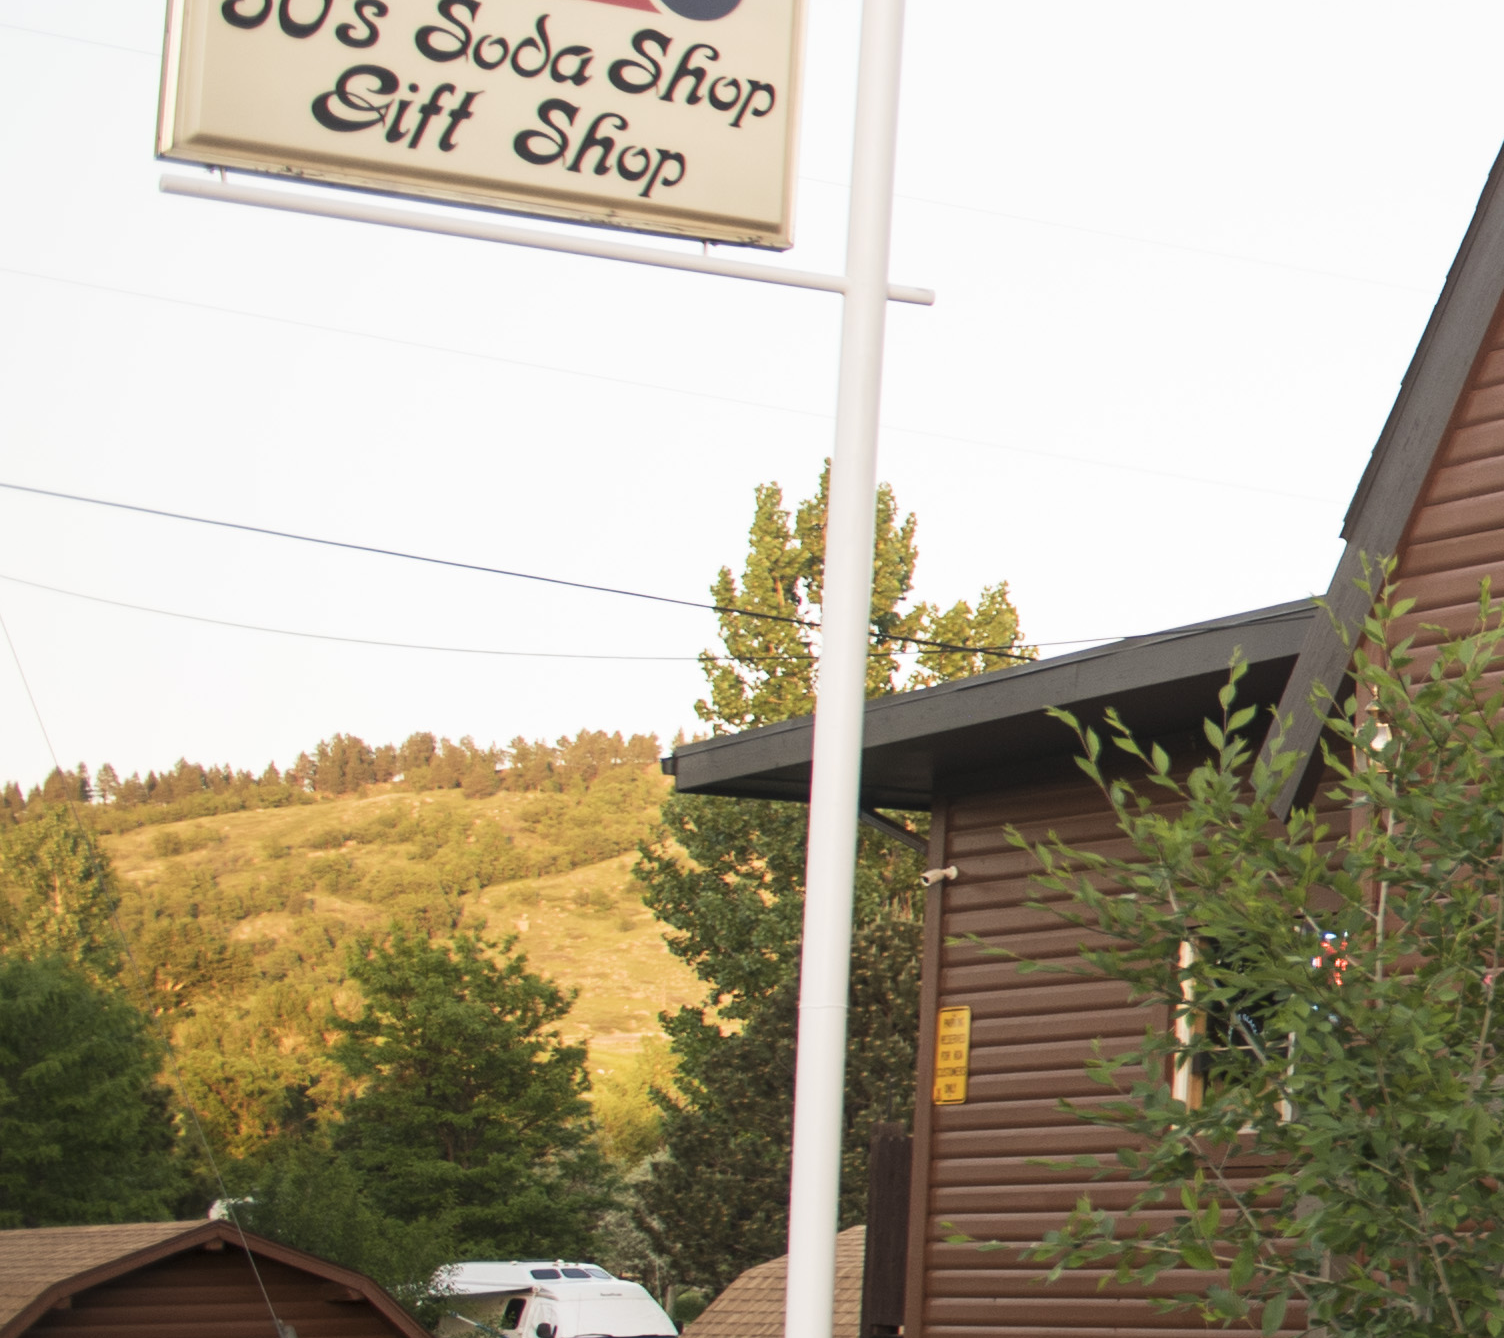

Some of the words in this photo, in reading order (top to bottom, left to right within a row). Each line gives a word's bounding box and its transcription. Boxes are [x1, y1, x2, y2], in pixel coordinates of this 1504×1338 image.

[312, 64, 484, 152] Gift
[513, 99, 686, 198] Shop
[607, 29, 776, 129] Shop
